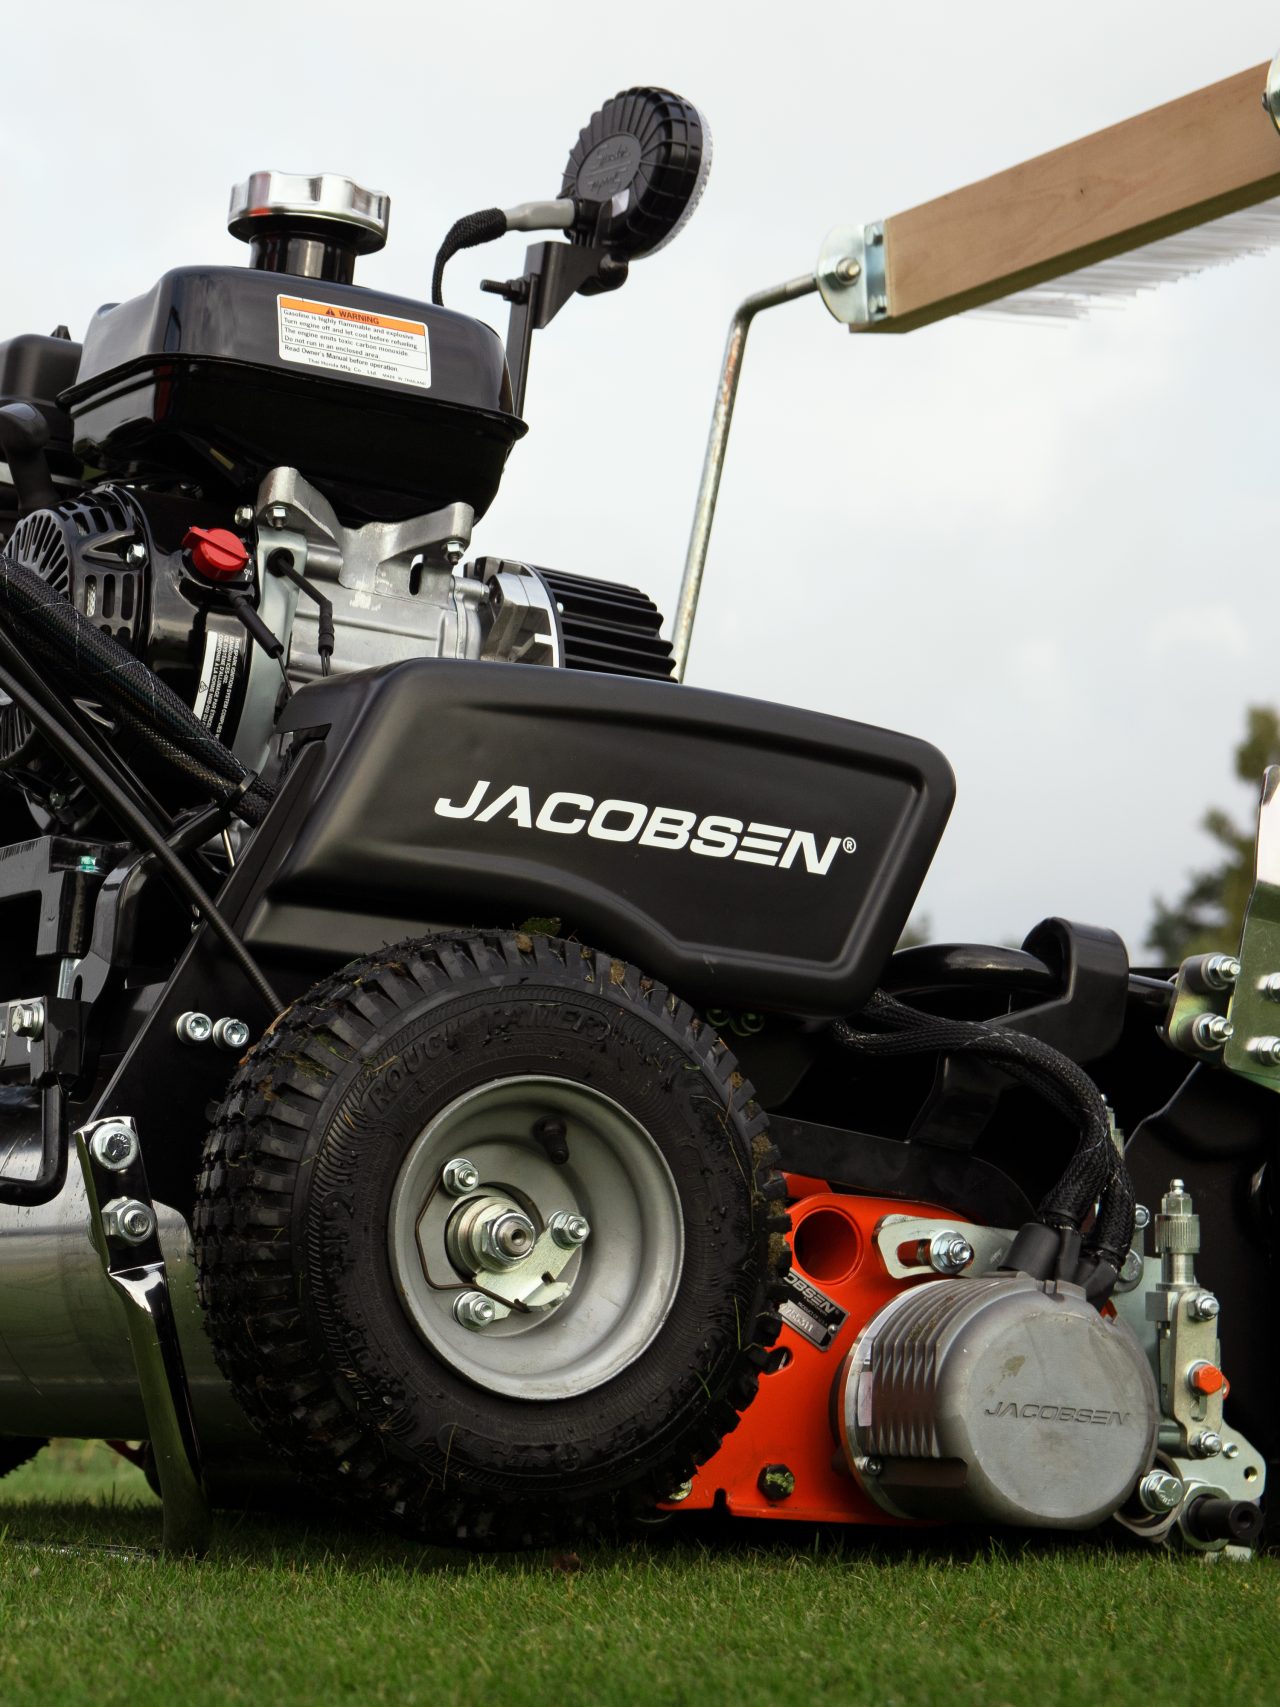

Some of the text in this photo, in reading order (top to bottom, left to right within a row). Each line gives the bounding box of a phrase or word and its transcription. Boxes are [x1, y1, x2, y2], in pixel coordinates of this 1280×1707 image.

[283, 309, 310, 319] Gasoline
[318, 316, 336, 325] highly
[338, 320, 371, 332] flammable
[339, 310, 380, 325] WARNING
[284, 317, 298, 325] Turn
[299, 320, 320, 330] engine
[354, 331, 368, 339] cool
[369, 334, 389, 343] before
[297, 330, 318, 339] engine
[319, 334, 337, 342] emits
[355, 341, 377, 350] carbon
[284, 344, 300, 353] Read
[301, 347, 325, 357] Owner's
[326, 352, 348, 362] Manual
[349, 357, 369, 366] before
[335, 345, 363, 356] enclosed
[321, 360, 339, 368] Honda
[223, 688, 232, 709] SYSTEM
[783, 1272, 836, 1314] OBSEN
[984, 1401, 1131, 1426] JACOBSEN
